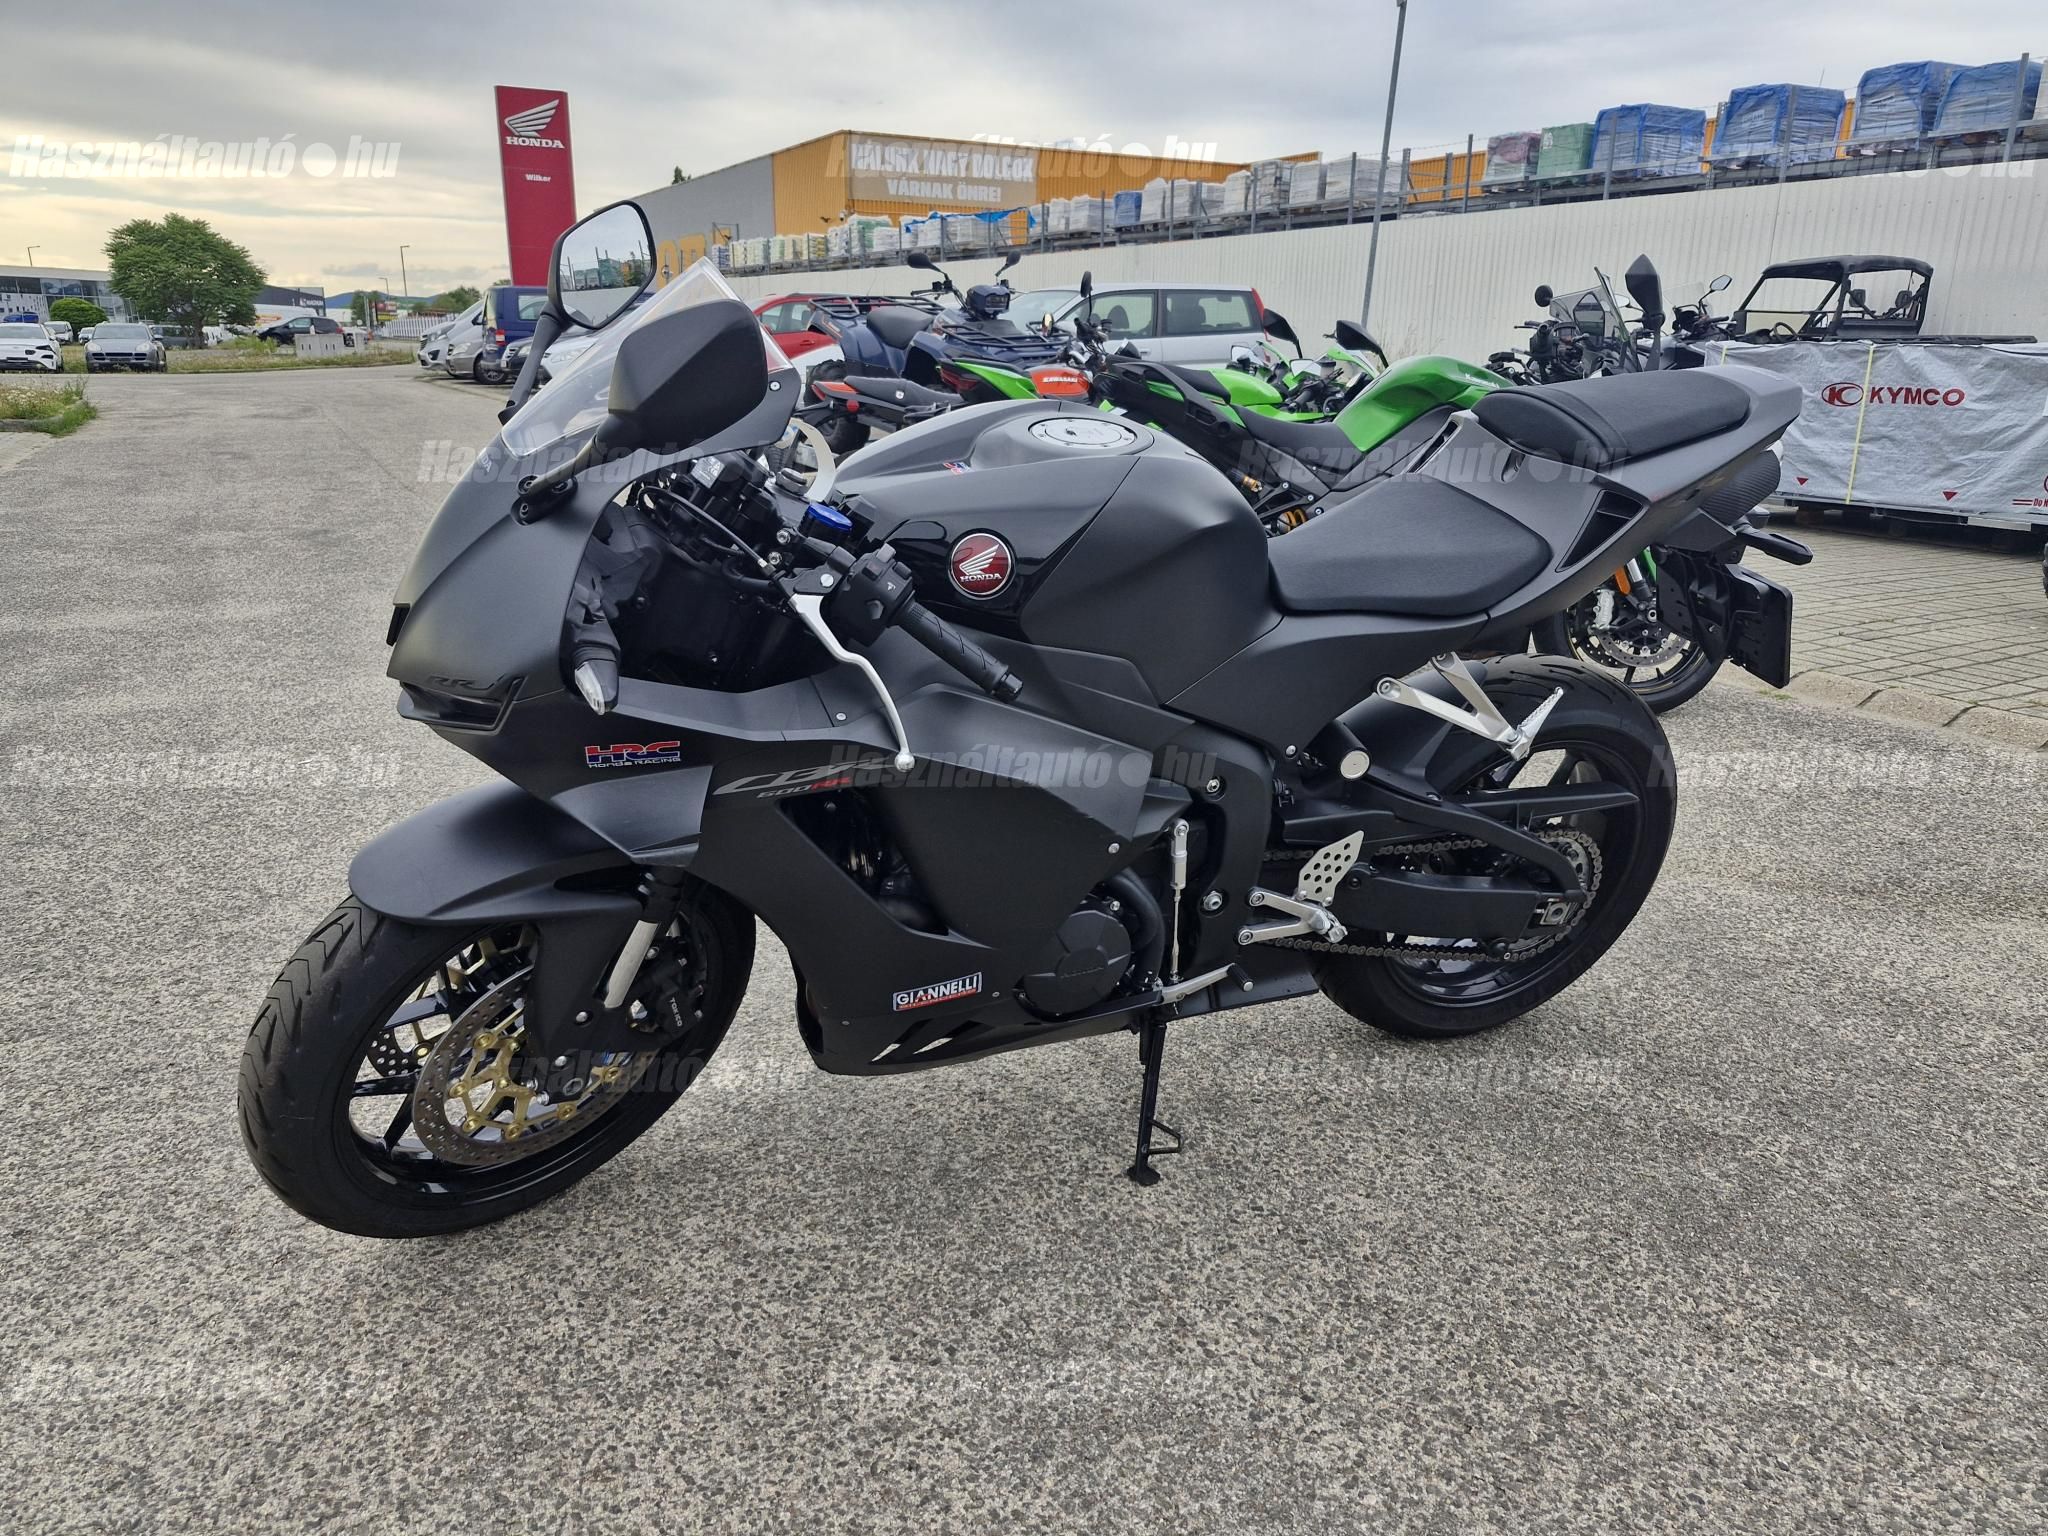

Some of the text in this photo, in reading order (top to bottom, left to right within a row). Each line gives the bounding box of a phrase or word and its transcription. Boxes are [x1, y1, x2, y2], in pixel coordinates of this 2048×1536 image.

[505, 136, 565, 149] HONDA
[887, 176, 954, 201] VÁRNAK
[1869, 386, 1965, 406] KYMCO
[959, 572, 1003, 583] HONDA
[584, 740, 681, 764] HRC
[587, 758, 682, 769] Honda RACING
[896, 975, 977, 1006] GIANNELLI
[668, 996, 683, 1028] TOKICO
